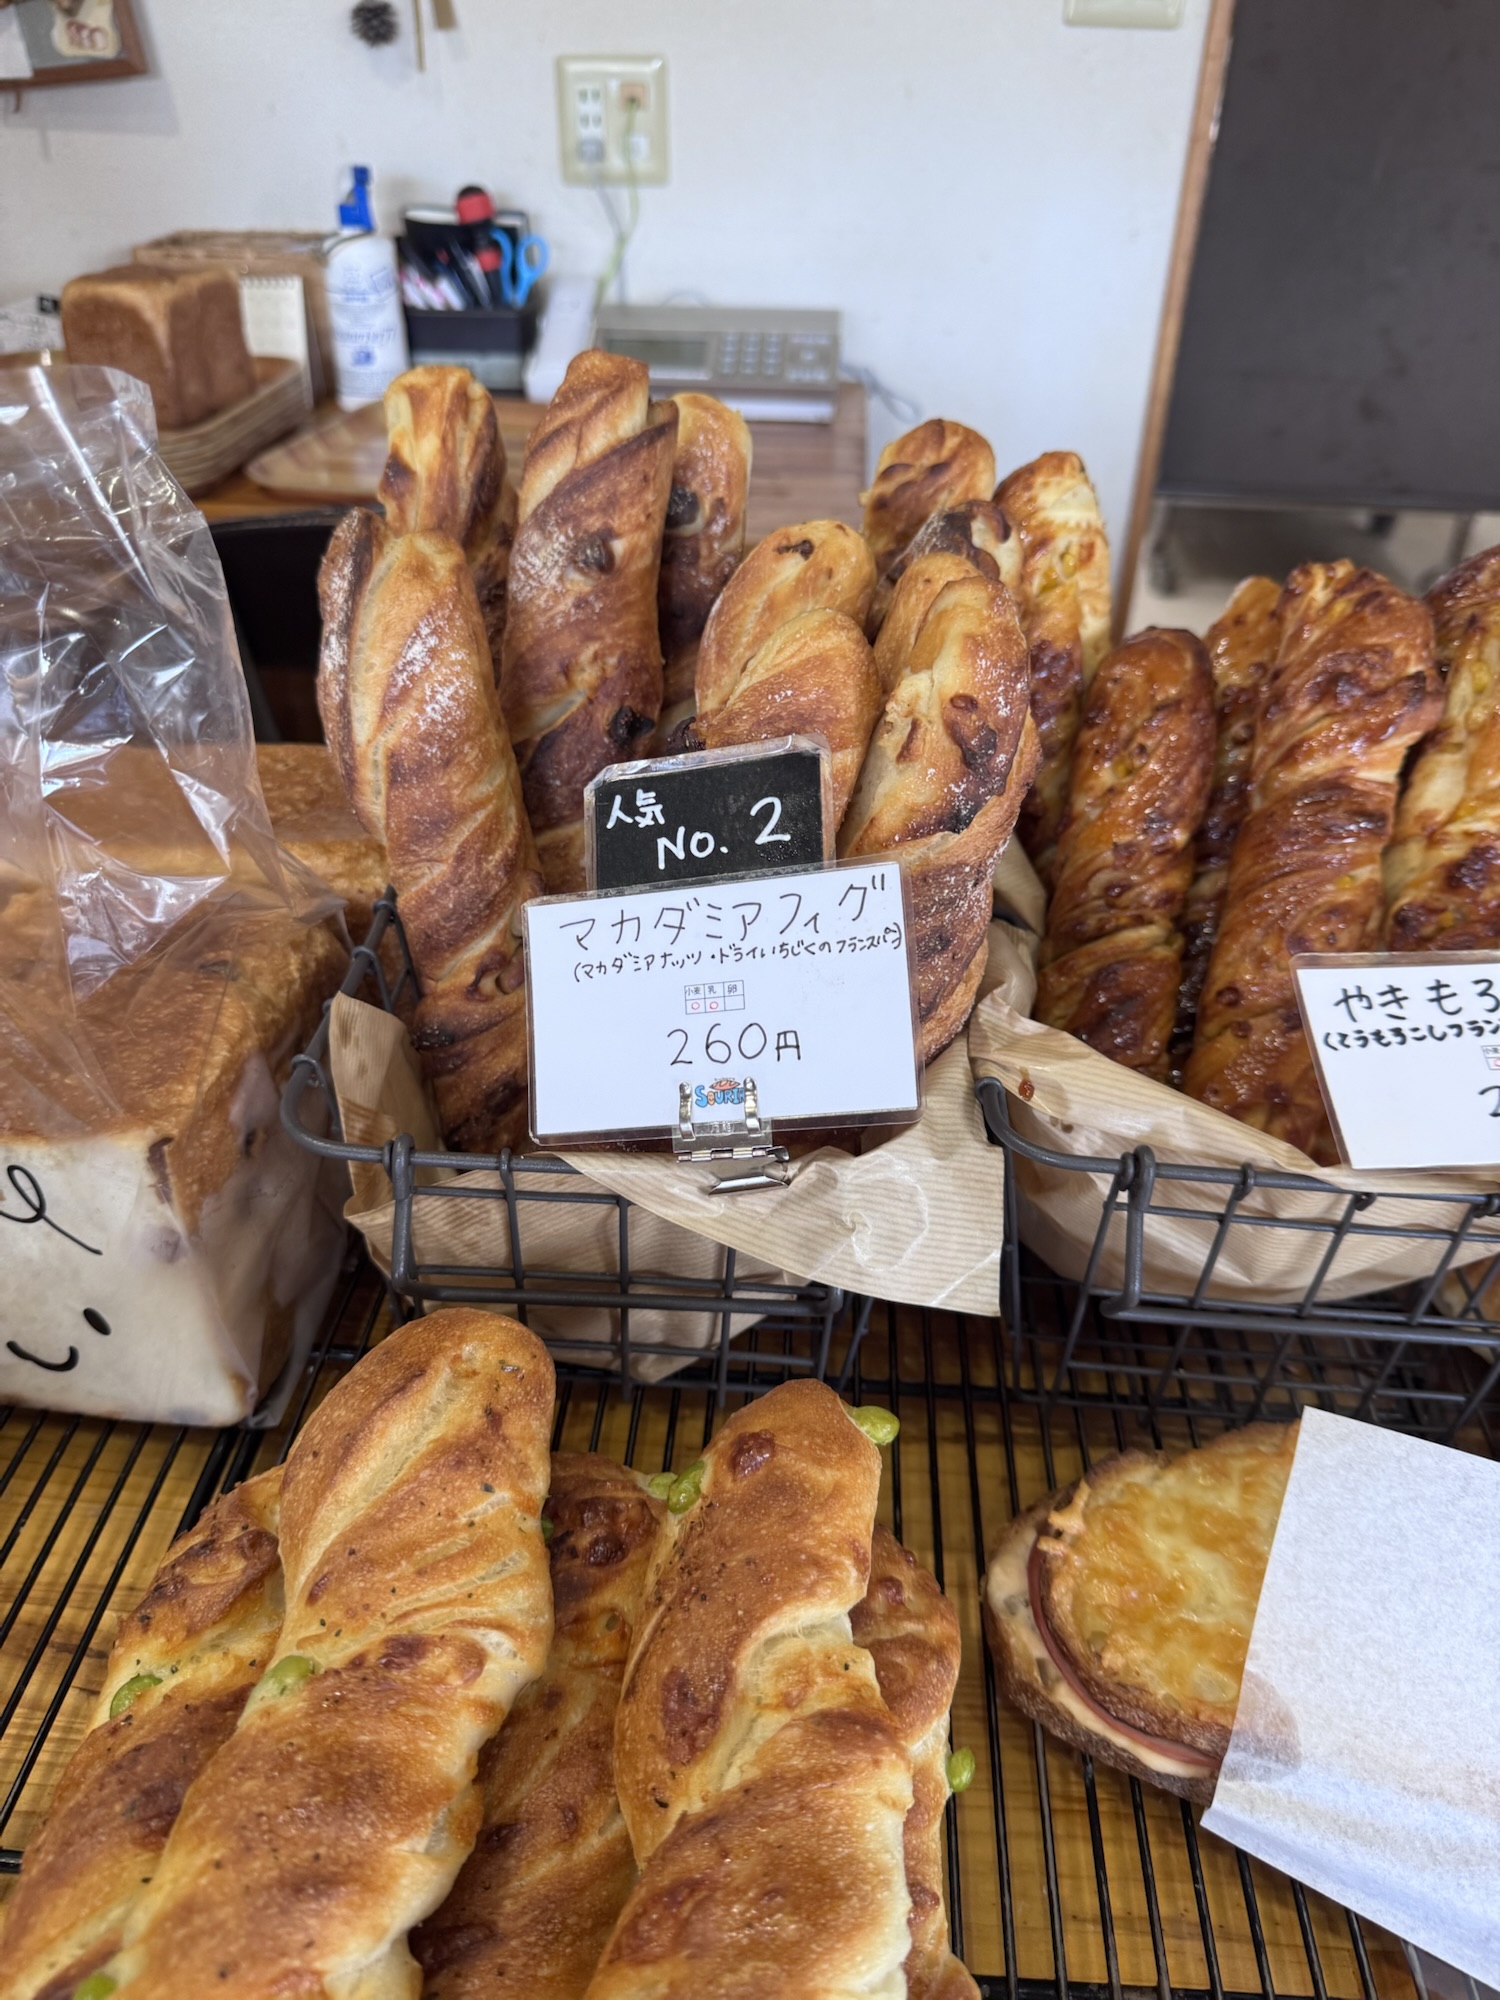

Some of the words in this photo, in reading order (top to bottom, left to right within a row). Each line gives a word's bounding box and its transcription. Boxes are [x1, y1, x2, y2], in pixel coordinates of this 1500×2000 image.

[606, 788, 666, 829] 人気
[750, 796, 791, 845] 2
[559, 873, 886, 950] マカダミアフィグ
[1333, 978, 1500, 1023] やきもろ
[667, 1022, 801, 1066] 260円
